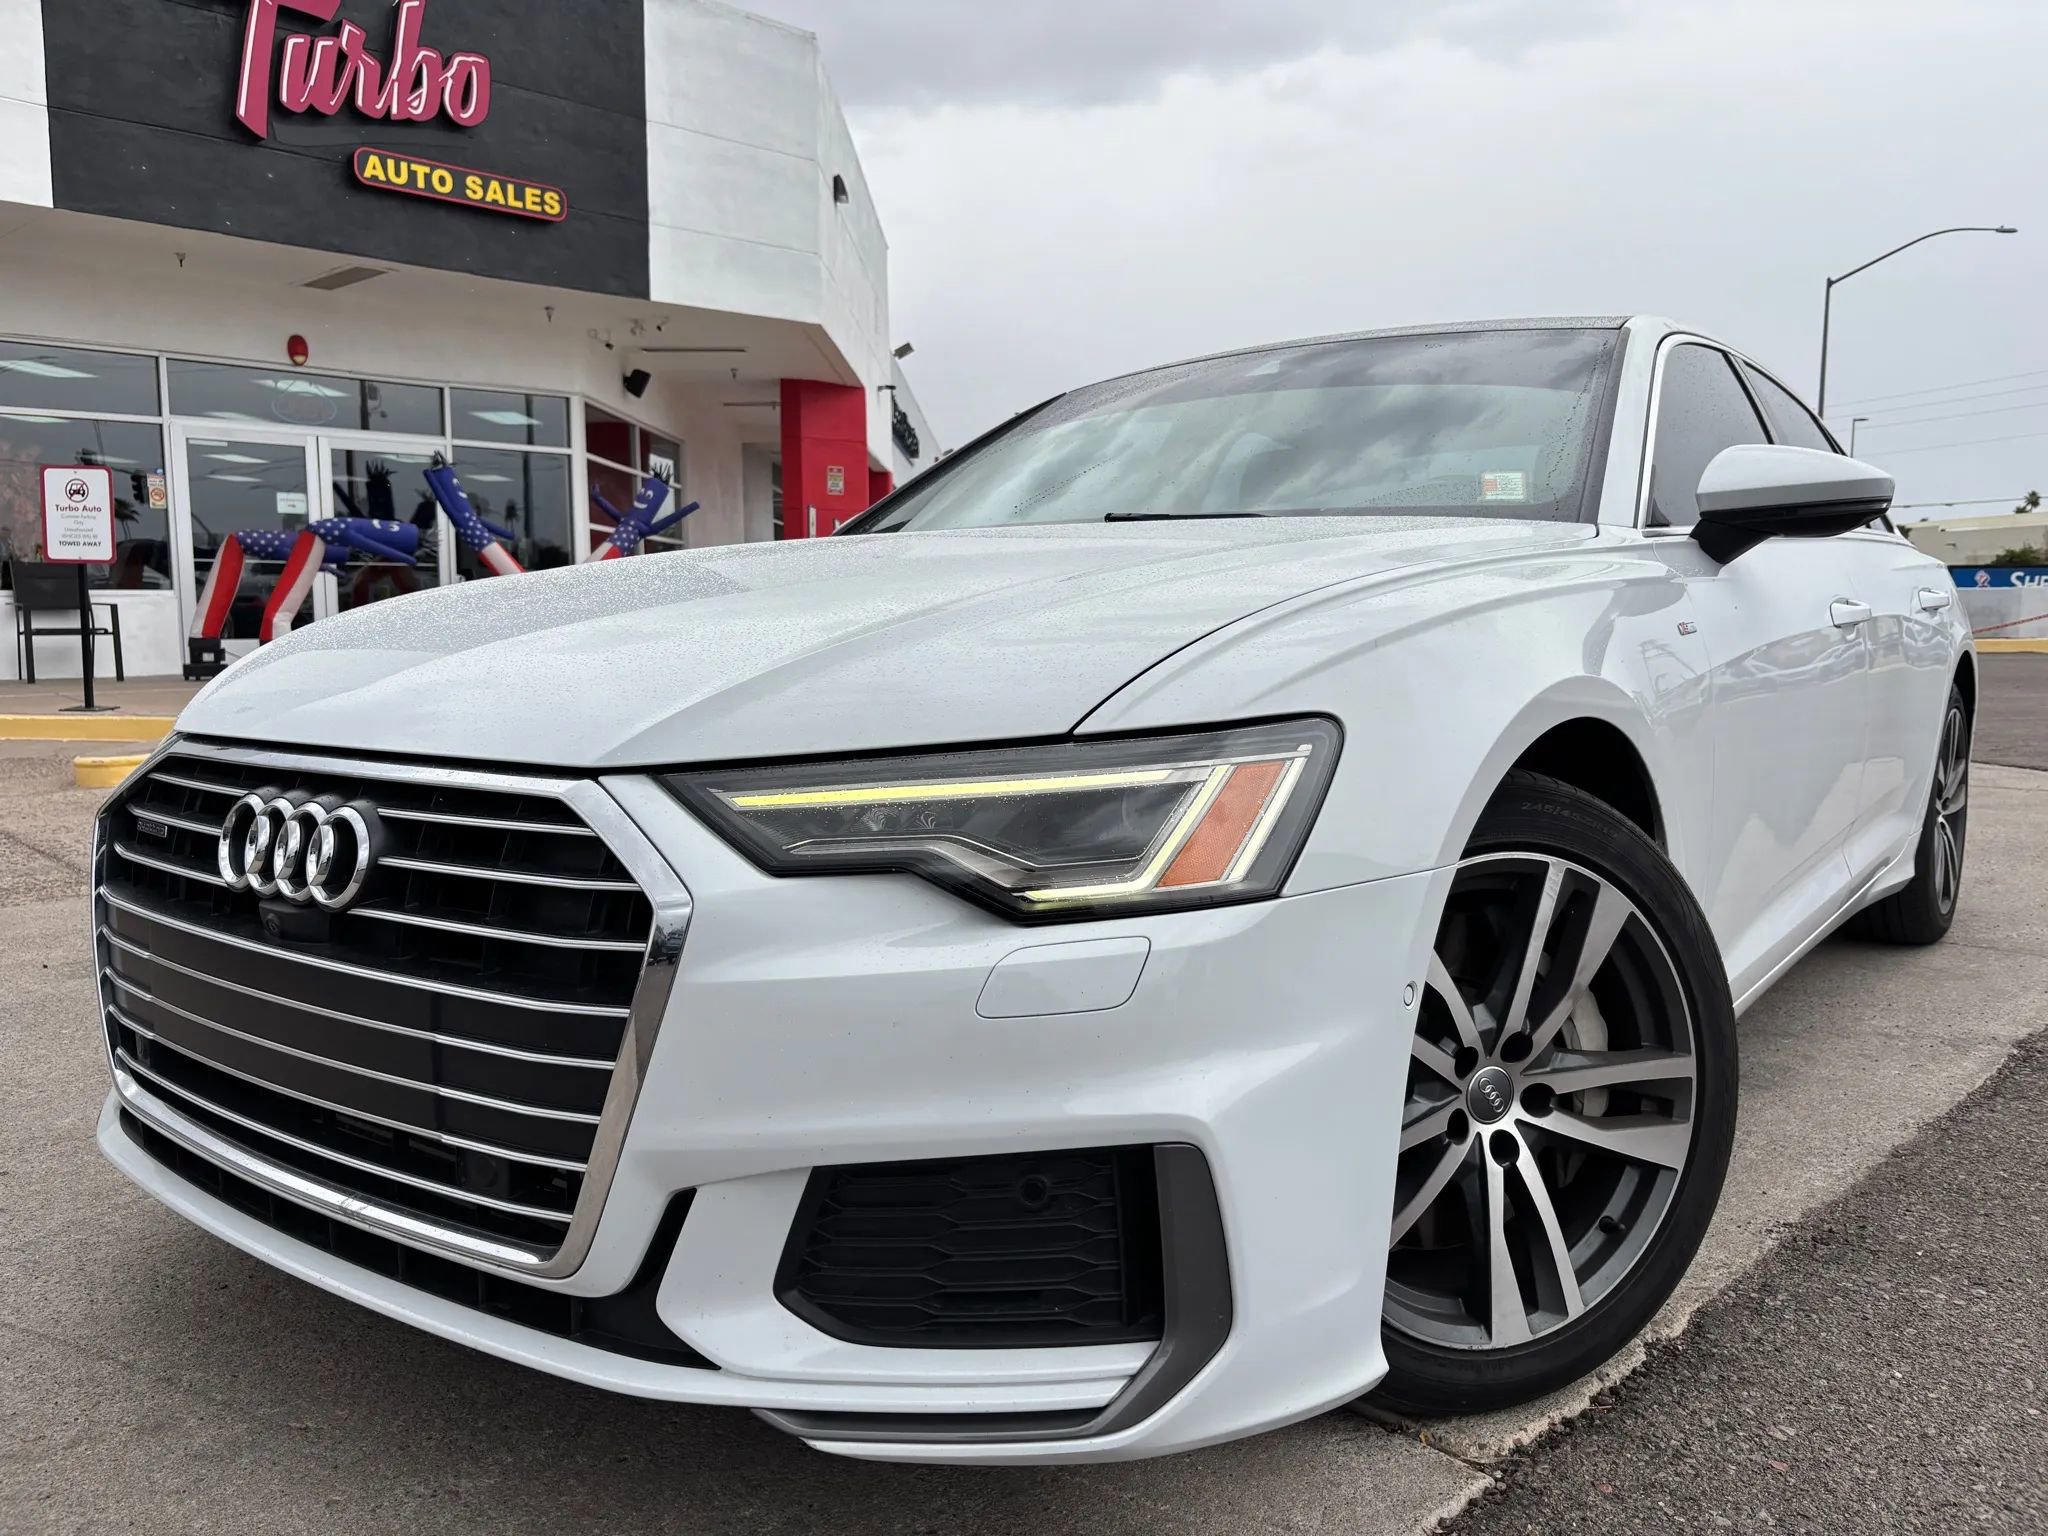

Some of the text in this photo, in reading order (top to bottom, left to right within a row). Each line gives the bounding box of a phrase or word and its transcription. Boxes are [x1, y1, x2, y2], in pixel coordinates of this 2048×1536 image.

[236, 0, 491, 139] Turbo
[363, 154, 561, 216] AUTO SALES
[55, 504, 102, 513] Turbo Auto
